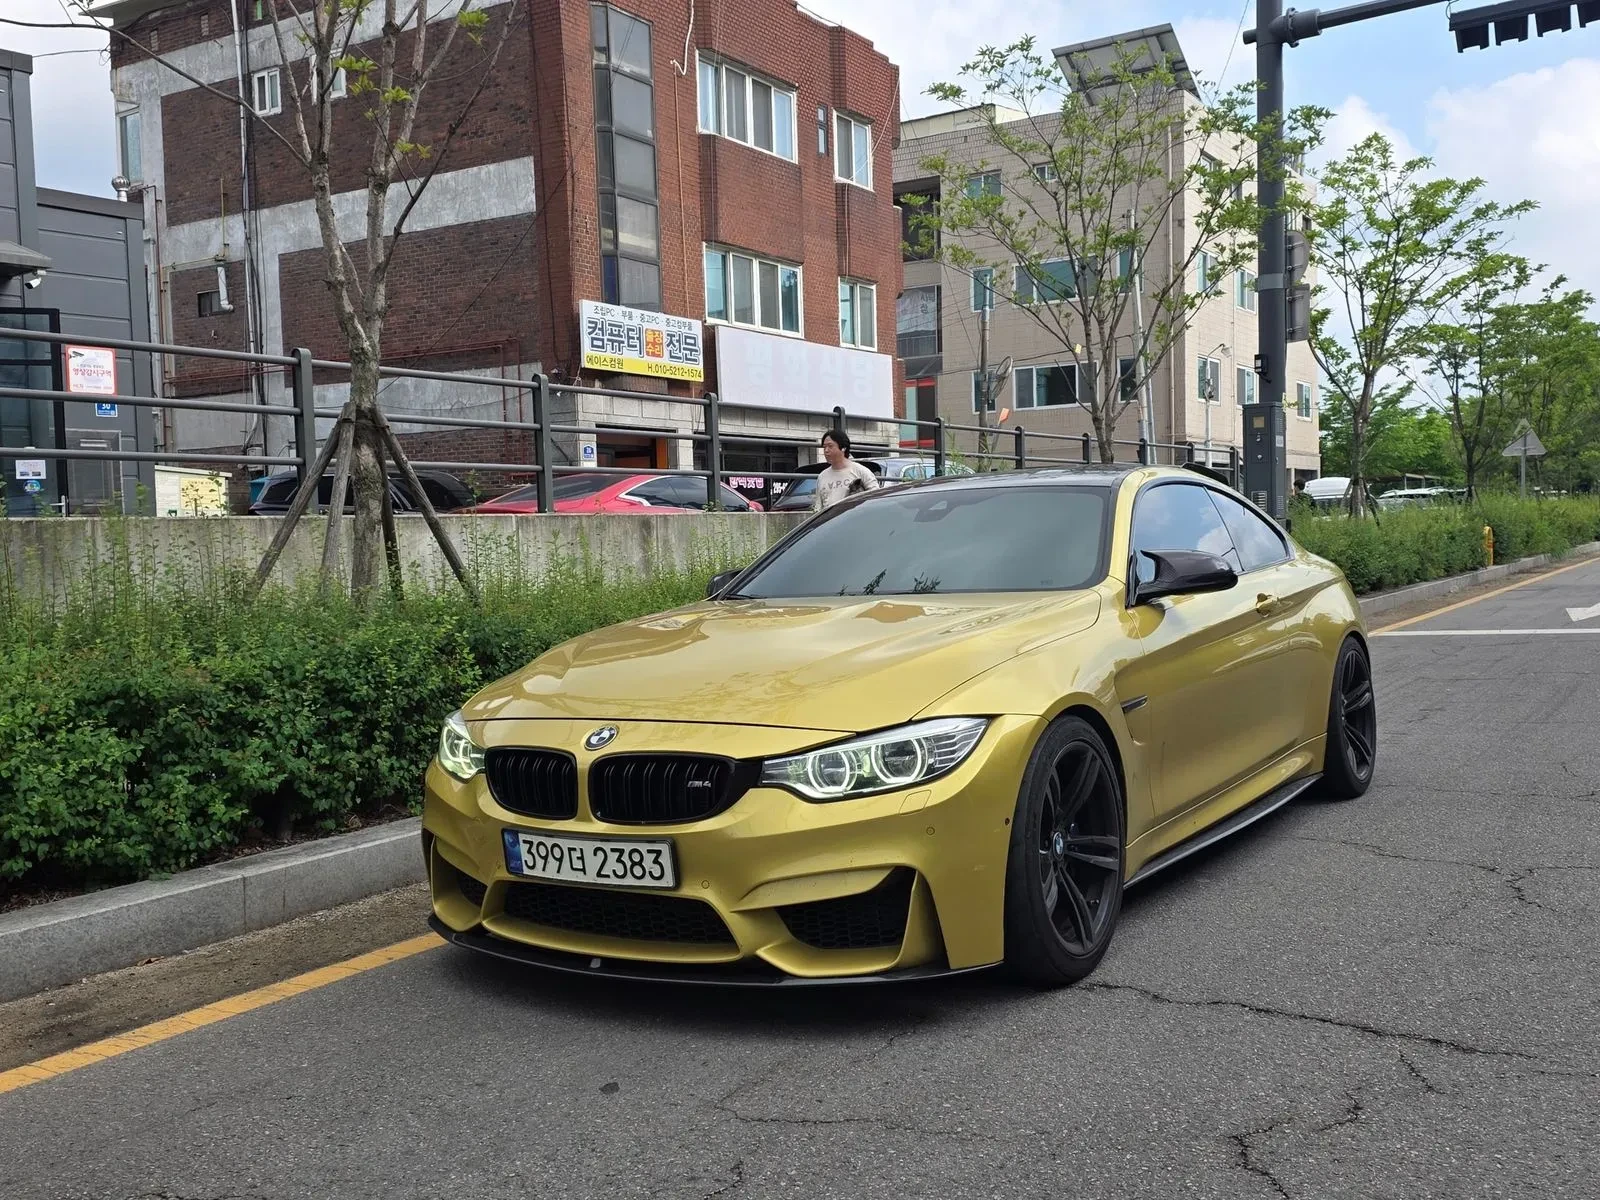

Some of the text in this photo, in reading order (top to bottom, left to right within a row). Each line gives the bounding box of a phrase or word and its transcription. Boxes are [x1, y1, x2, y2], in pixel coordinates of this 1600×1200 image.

[586, 317, 702, 366] 컴퓨터 전문
[645, 344, 663, 357] 수리
[522, 839, 665, 881] 399더 2383
